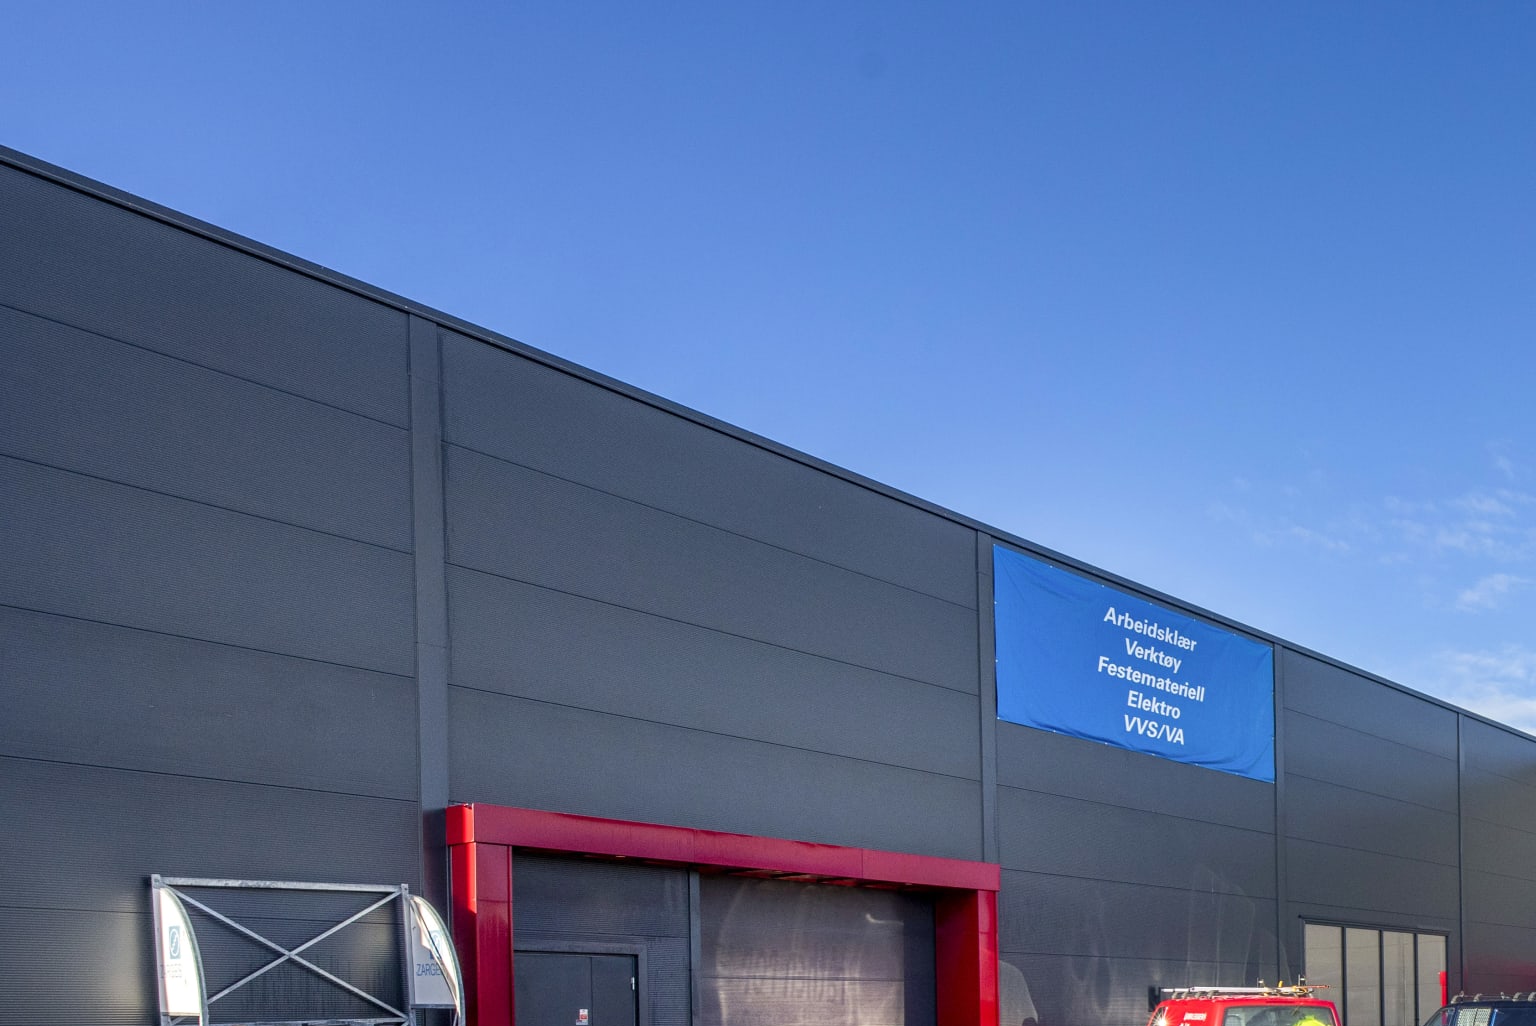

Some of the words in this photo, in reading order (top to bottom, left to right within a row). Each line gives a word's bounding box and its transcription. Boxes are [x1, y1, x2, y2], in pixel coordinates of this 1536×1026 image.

[1104, 607, 1197, 651] Arbeidsklær
[1125, 638, 1182, 673] Verktøy
[1098, 656, 1205, 702] Festemateriell
[1127, 691, 1181, 719] Elektro
[1124, 715, 1185, 745] VVS/VA
[416, 963, 443, 977] ZARGE
